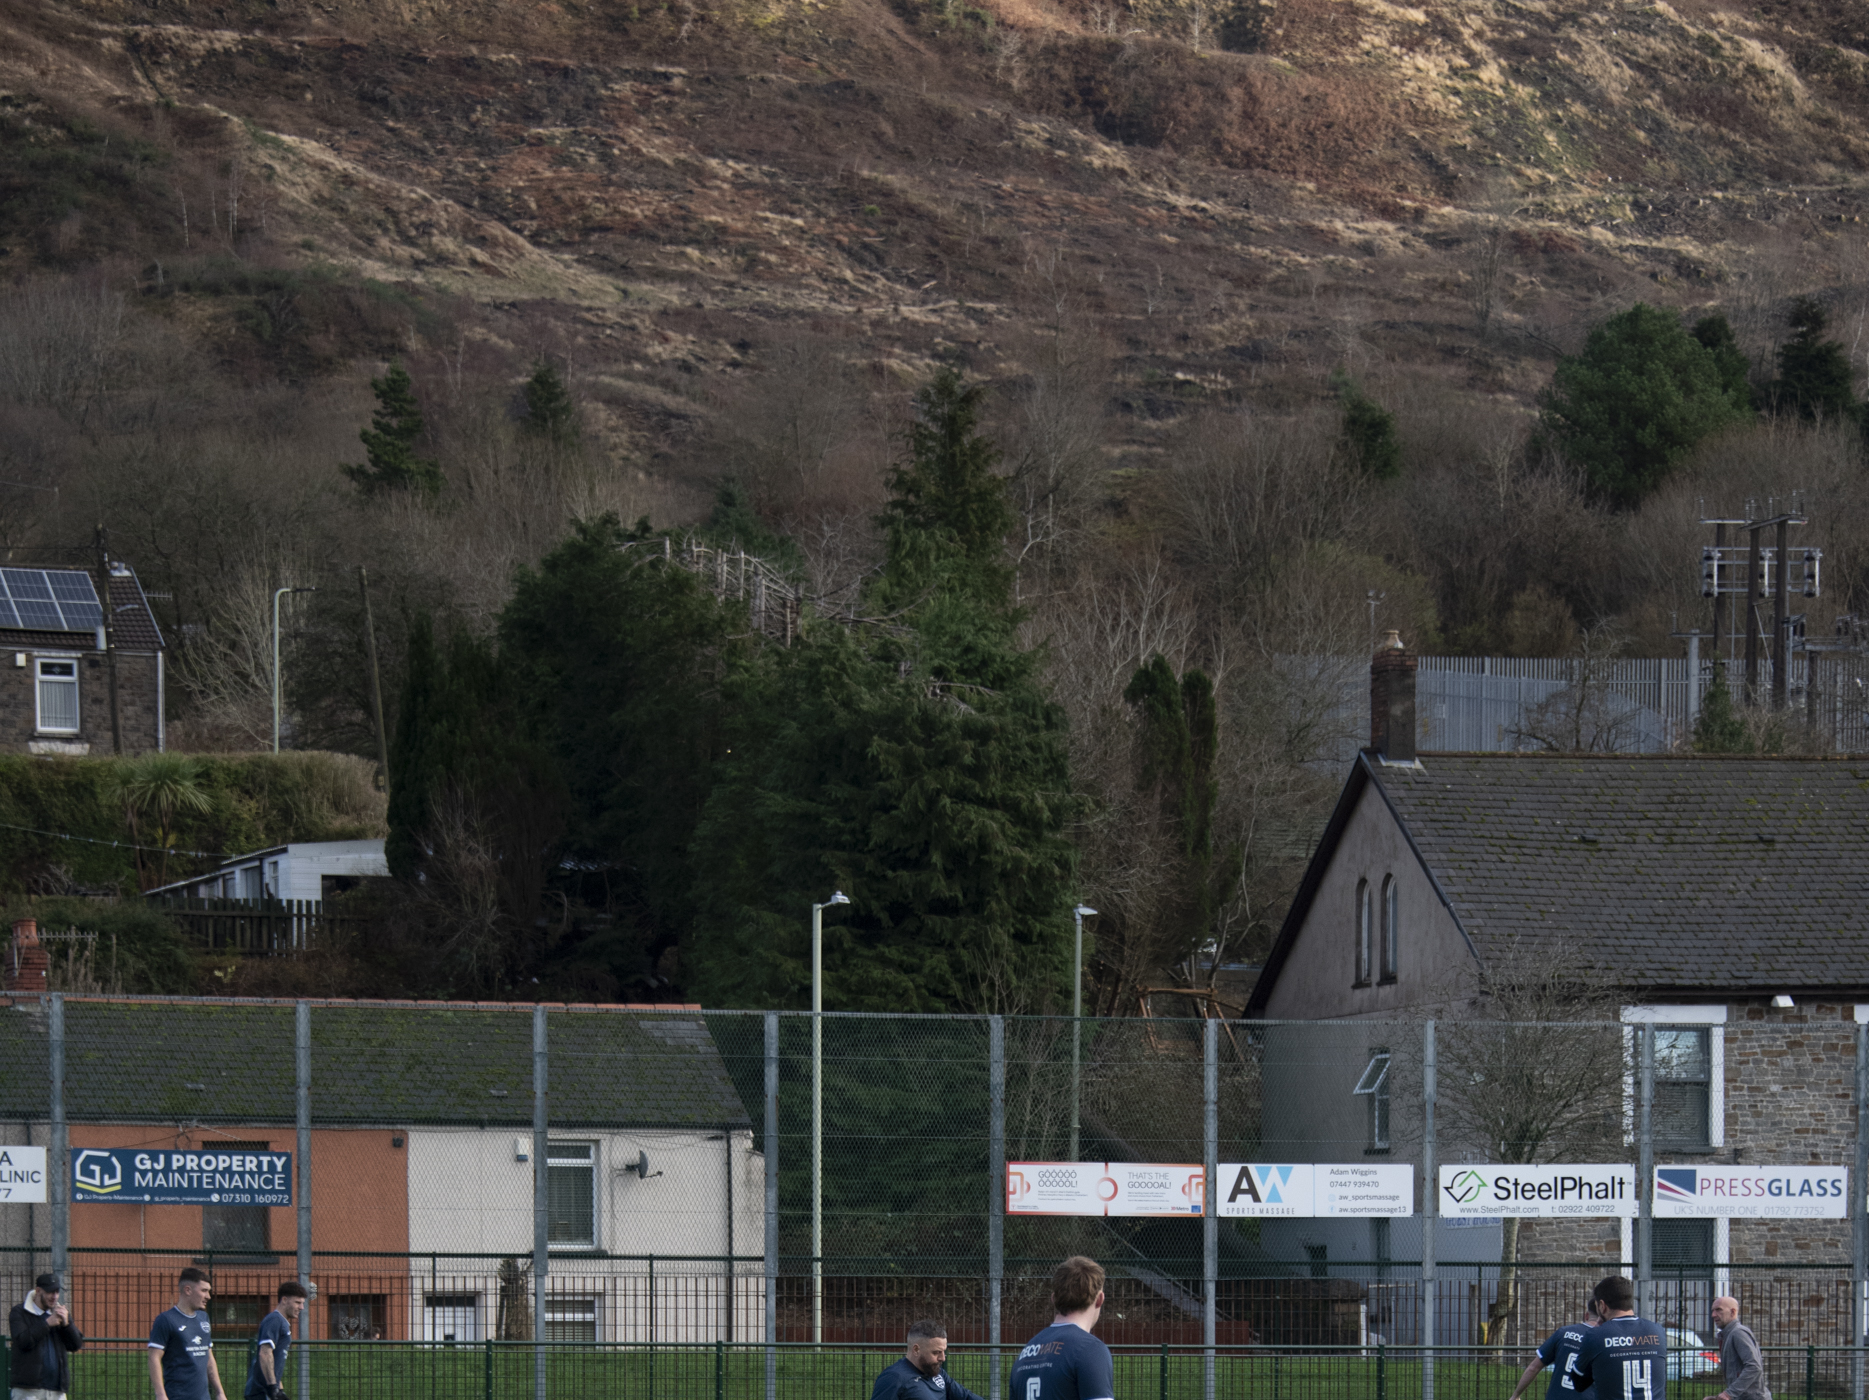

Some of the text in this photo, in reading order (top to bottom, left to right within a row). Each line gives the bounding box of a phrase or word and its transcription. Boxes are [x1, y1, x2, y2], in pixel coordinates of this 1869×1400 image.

[134, 1153, 287, 1172] GJ PROPERTY
[1128, 1172, 1169, 1180] THAT'S THE
[1350, 1168, 1378, 1177] Wiggins
[134, 1171, 286, 1190] MAINTENANCE
[1493, 1176, 1625, 1201] SteelPhalt
[222, 1193, 289, 1204] 07310 160972
[1338, 1194, 1400, 1202] aw_sportsmassage
[1226, 1207, 1295, 1215] SPORTS MASSAGE
[1338, 1206, 1407, 1214] aw.sportsmassage13
[1459, 1205, 1540, 1214] www.SteelPhalt.com
[1558, 1205, 1583, 1214] 02922
[1585, 1205, 1615, 1213] 409722
[1674, 1206, 1825, 1215] UK'S NUMBER ONE 01792 773752
[1604, 1335, 1660, 1348] DECOMATE
